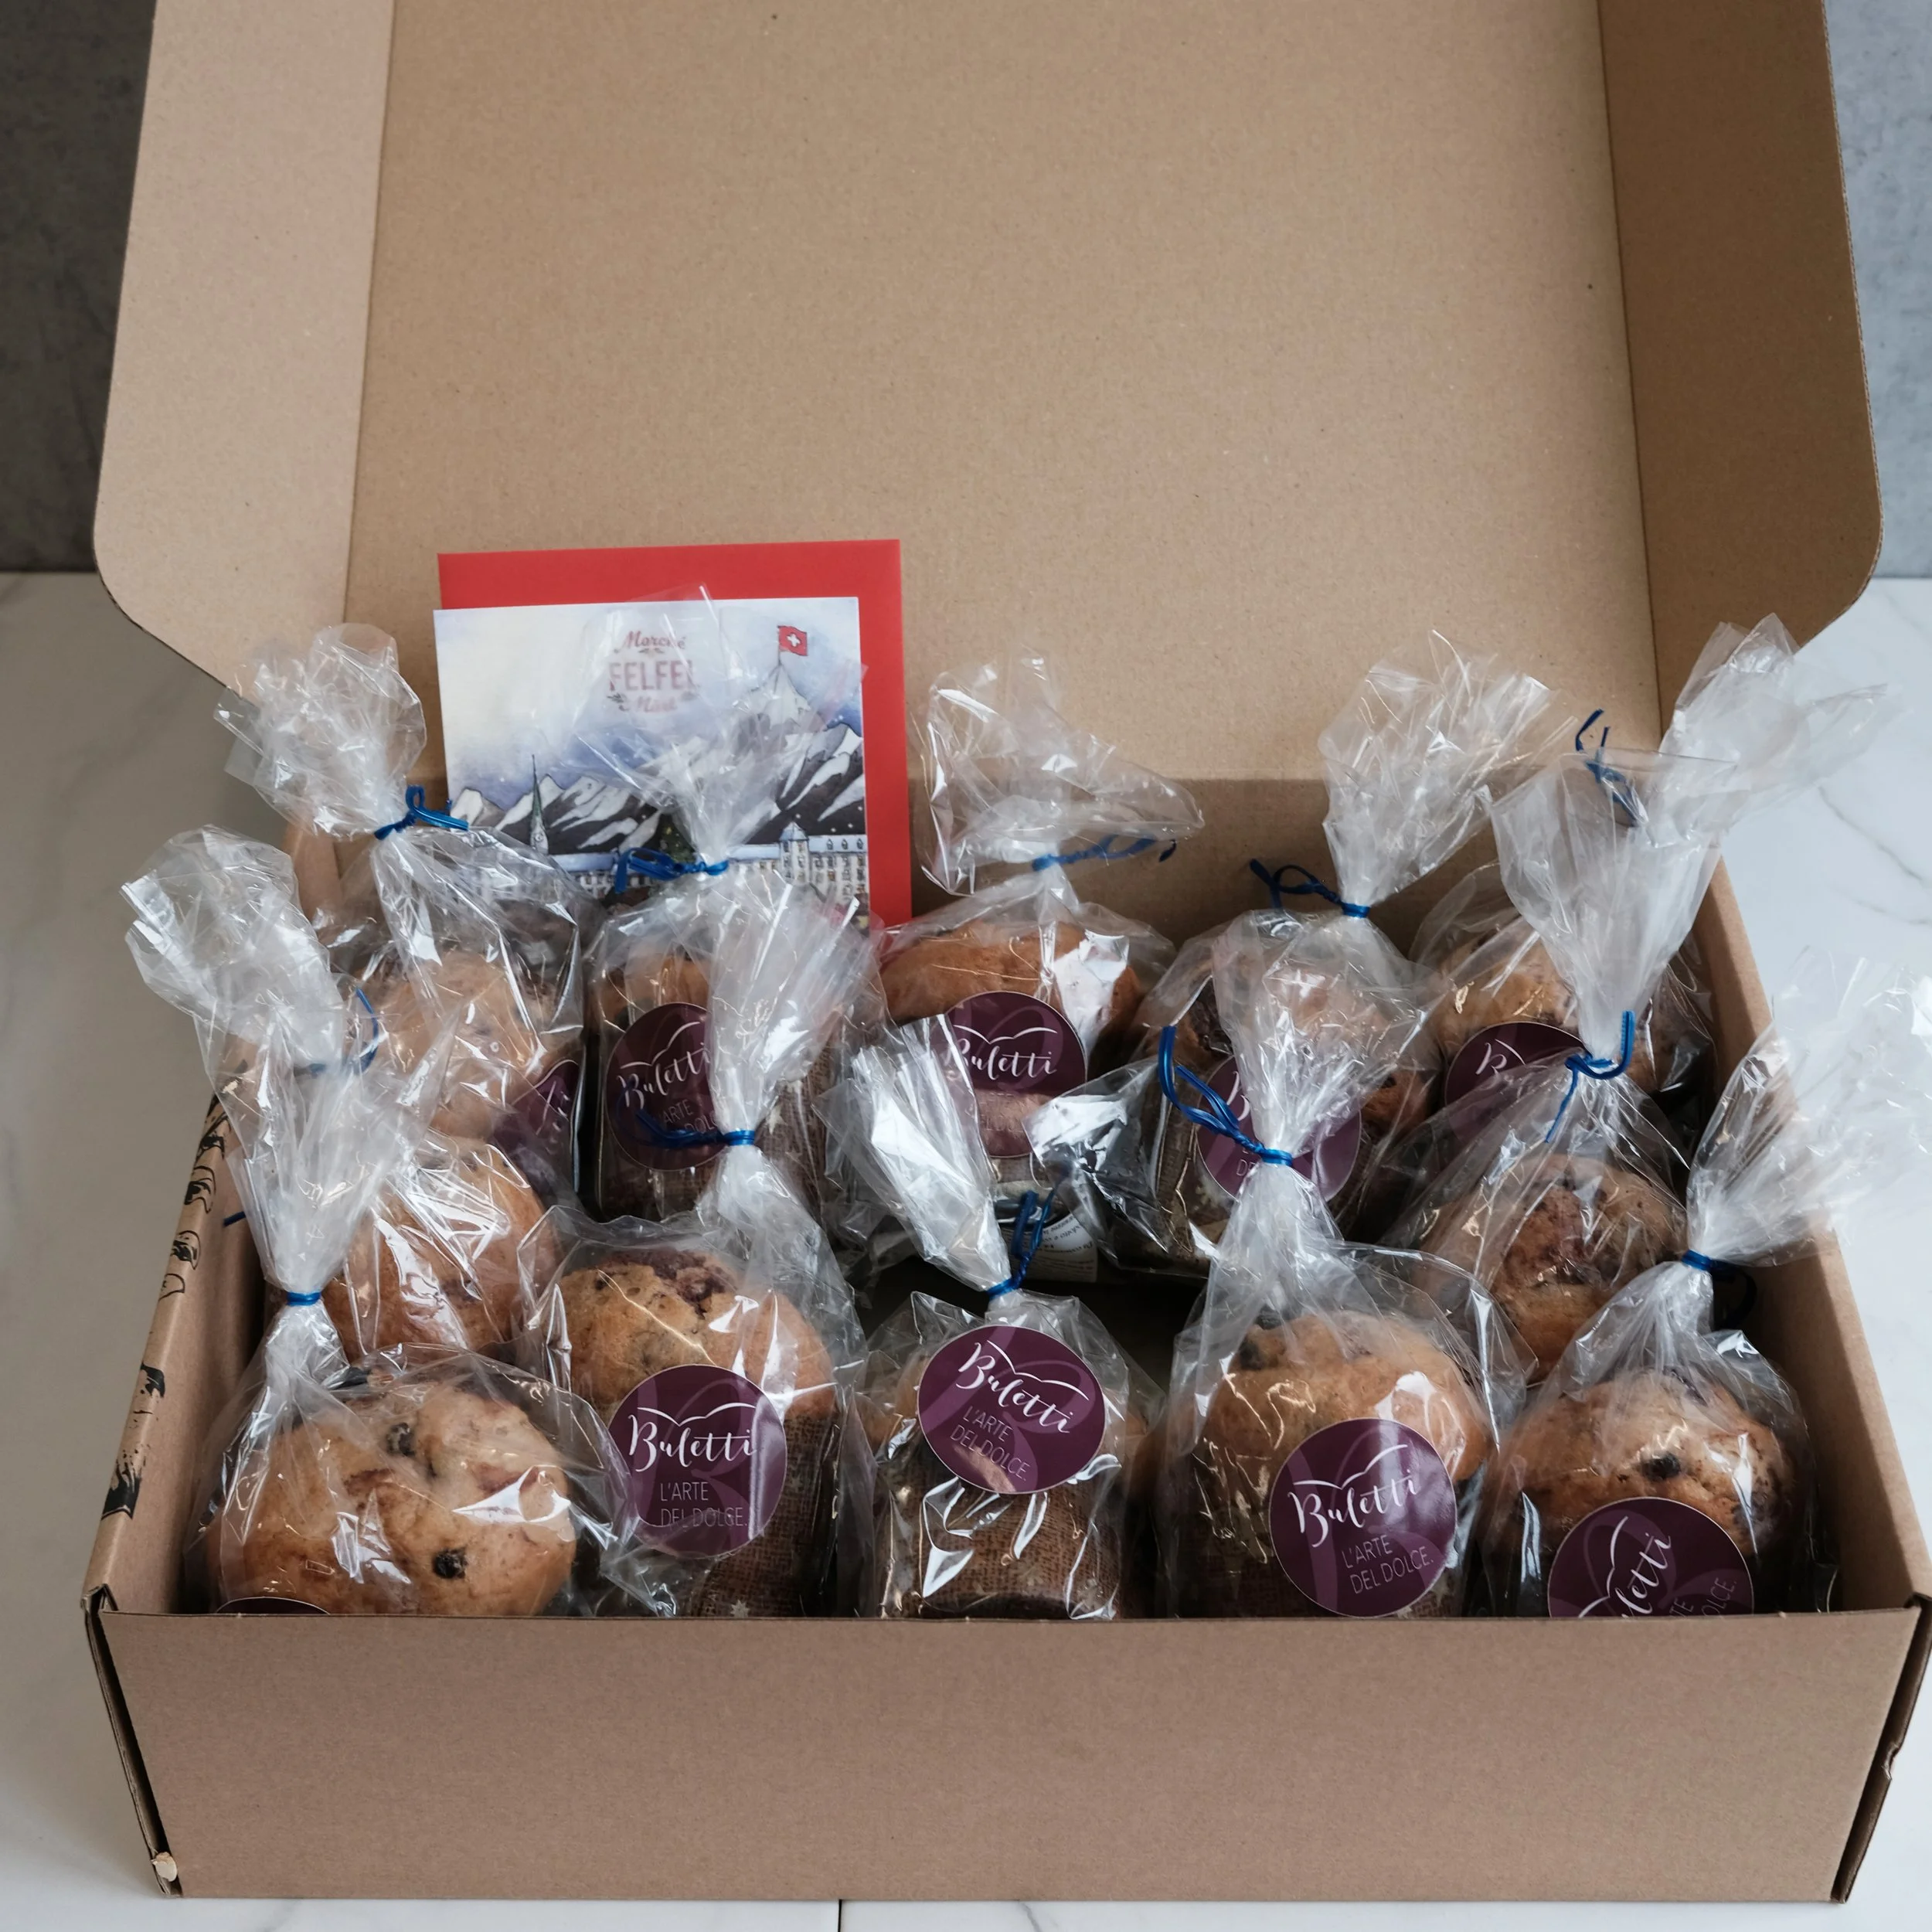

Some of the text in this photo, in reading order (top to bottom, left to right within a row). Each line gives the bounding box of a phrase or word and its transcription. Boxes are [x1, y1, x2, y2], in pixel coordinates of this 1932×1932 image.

[955, 1342, 1071, 1434] Buletti
[950, 1424, 978, 1452] DEL
[962, 1406, 1014, 1443] L'ARTE
[628, 1414, 757, 1472] Buletti
[660, 1481, 709, 1502] L'ARTE
[1287, 1468, 1418, 1548] Buletti
[660, 1508, 689, 1528] DEL
[1342, 1534, 1393, 1569] L'ARTE
[1349, 1569, 1382, 1595] DEL
[1614, 1532, 1672, 1620] letti
